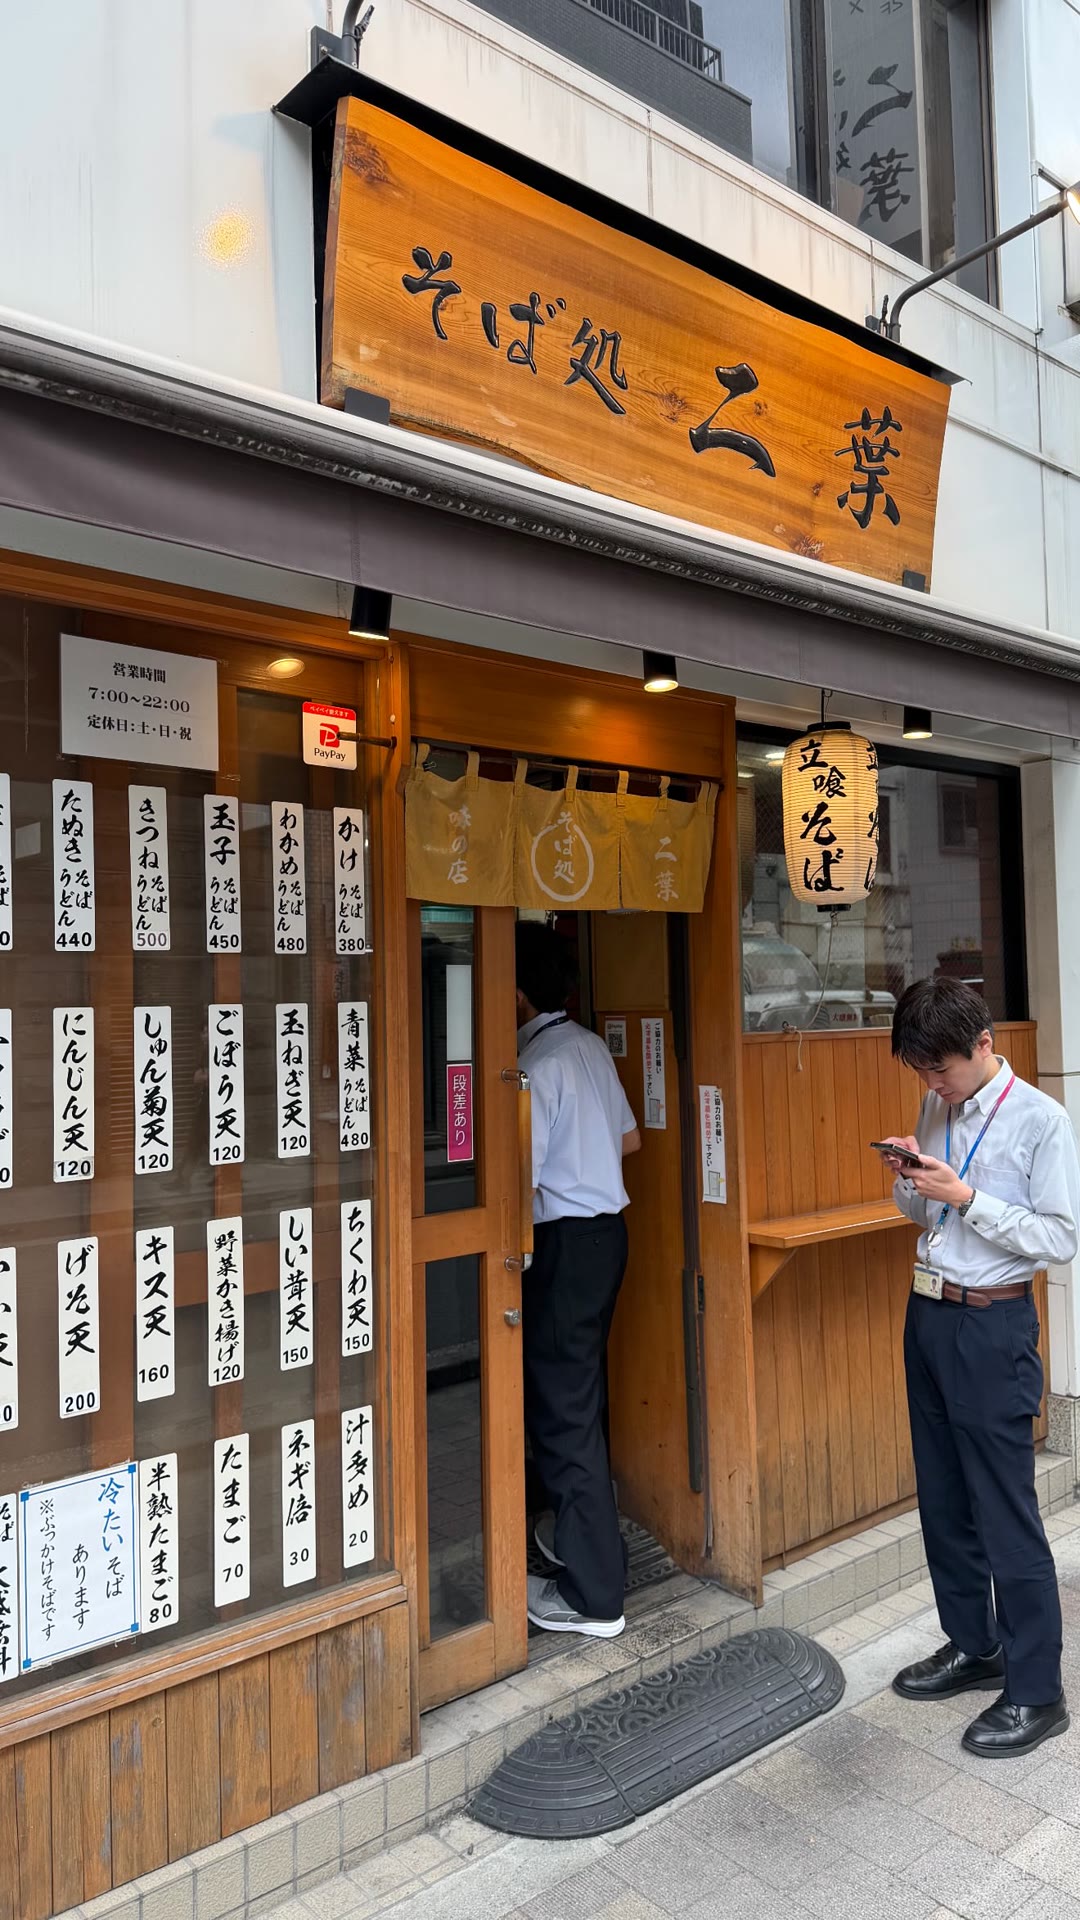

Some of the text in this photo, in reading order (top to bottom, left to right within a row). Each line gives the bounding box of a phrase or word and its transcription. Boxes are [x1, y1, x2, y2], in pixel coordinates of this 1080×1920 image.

[401, 246, 904, 530] そば処 二葉
[113, 662, 165, 683] 営業時間
[314, 748, 346, 761] PayPay
[61, 789, 83, 862] たぬき
[136, 798, 159, 869] きつね
[210, 803, 236, 865] 玉子
[797, 738, 848, 892] 立喰そば
[279, 808, 299, 875] わかめ
[338, 816, 359, 871] かけ
[447, 804, 472, 885] 味の店
[553, 811, 577, 885] そば処
[76, 870, 92, 909] そば
[151, 875, 167, 913] そば
[653, 836, 680, 902] 二葉
[58, 869, 75, 926] うどん
[136, 875, 151, 930] うどん
[209, 877, 222, 930] うどん
[224, 878, 238, 914] そば
[277, 880, 290, 931] うどん
[290, 881, 303, 916] そば
[338, 884, 350, 933] うどん
[350, 885, 363, 918] そば
[57, 932, 91, 947] 440
[137, 933, 166, 946] 500
[210, 935, 239, 948] 450
[277, 938, 304, 950] 480
[339, 938, 364, 951] 380
[341, 1008, 365, 1071] 青菜
[62, 1014, 88, 1151] にんじん天
[140, 1013, 168, 1147] しゅん菊天
[214, 1010, 241, 1138] ごぼう天
[281, 1009, 306, 1128] 玉ねぎ天
[343, 1079, 355, 1129] うどん
[355, 1078, 367, 1112] そば
[452, 1073, 467, 1146] 段差あり
[139, 1154, 168, 1169] 120
[214, 1145, 240, 1161] 120
[281, 1135, 307, 1150] 120
[341, 1133, 368, 1146] 480
[58, 1161, 90, 1176] 120
[143, 1236, 170, 1338] キス天
[284, 1216, 309, 1334] しい茸天
[348, 1207, 369, 1328] ちくわ天
[66, 1245, 95, 1356] げそ天
[215, 1231, 239, 1362] 野菜かき揚げ
[283, 1346, 308, 1363] 150
[345, 1334, 369, 1350] 150
[139, 1365, 168, 1383] 160
[214, 1364, 241, 1382] 120
[65, 1391, 96, 1413] 200
[286, 1430, 311, 1526] ネギ倍
[346, 1413, 369, 1509] 汁多め
[221, 1444, 245, 1543] たまご
[98, 1477, 125, 1598] 冷たいそば
[147, 1463, 173, 1600] 半熟たまご
[290, 1549, 308, 1565] 30
[350, 1531, 367, 1547] 20
[73, 1544, 89, 1629] あります
[224, 1564, 243, 1582] 70
[150, 1604, 171, 1623] 80
